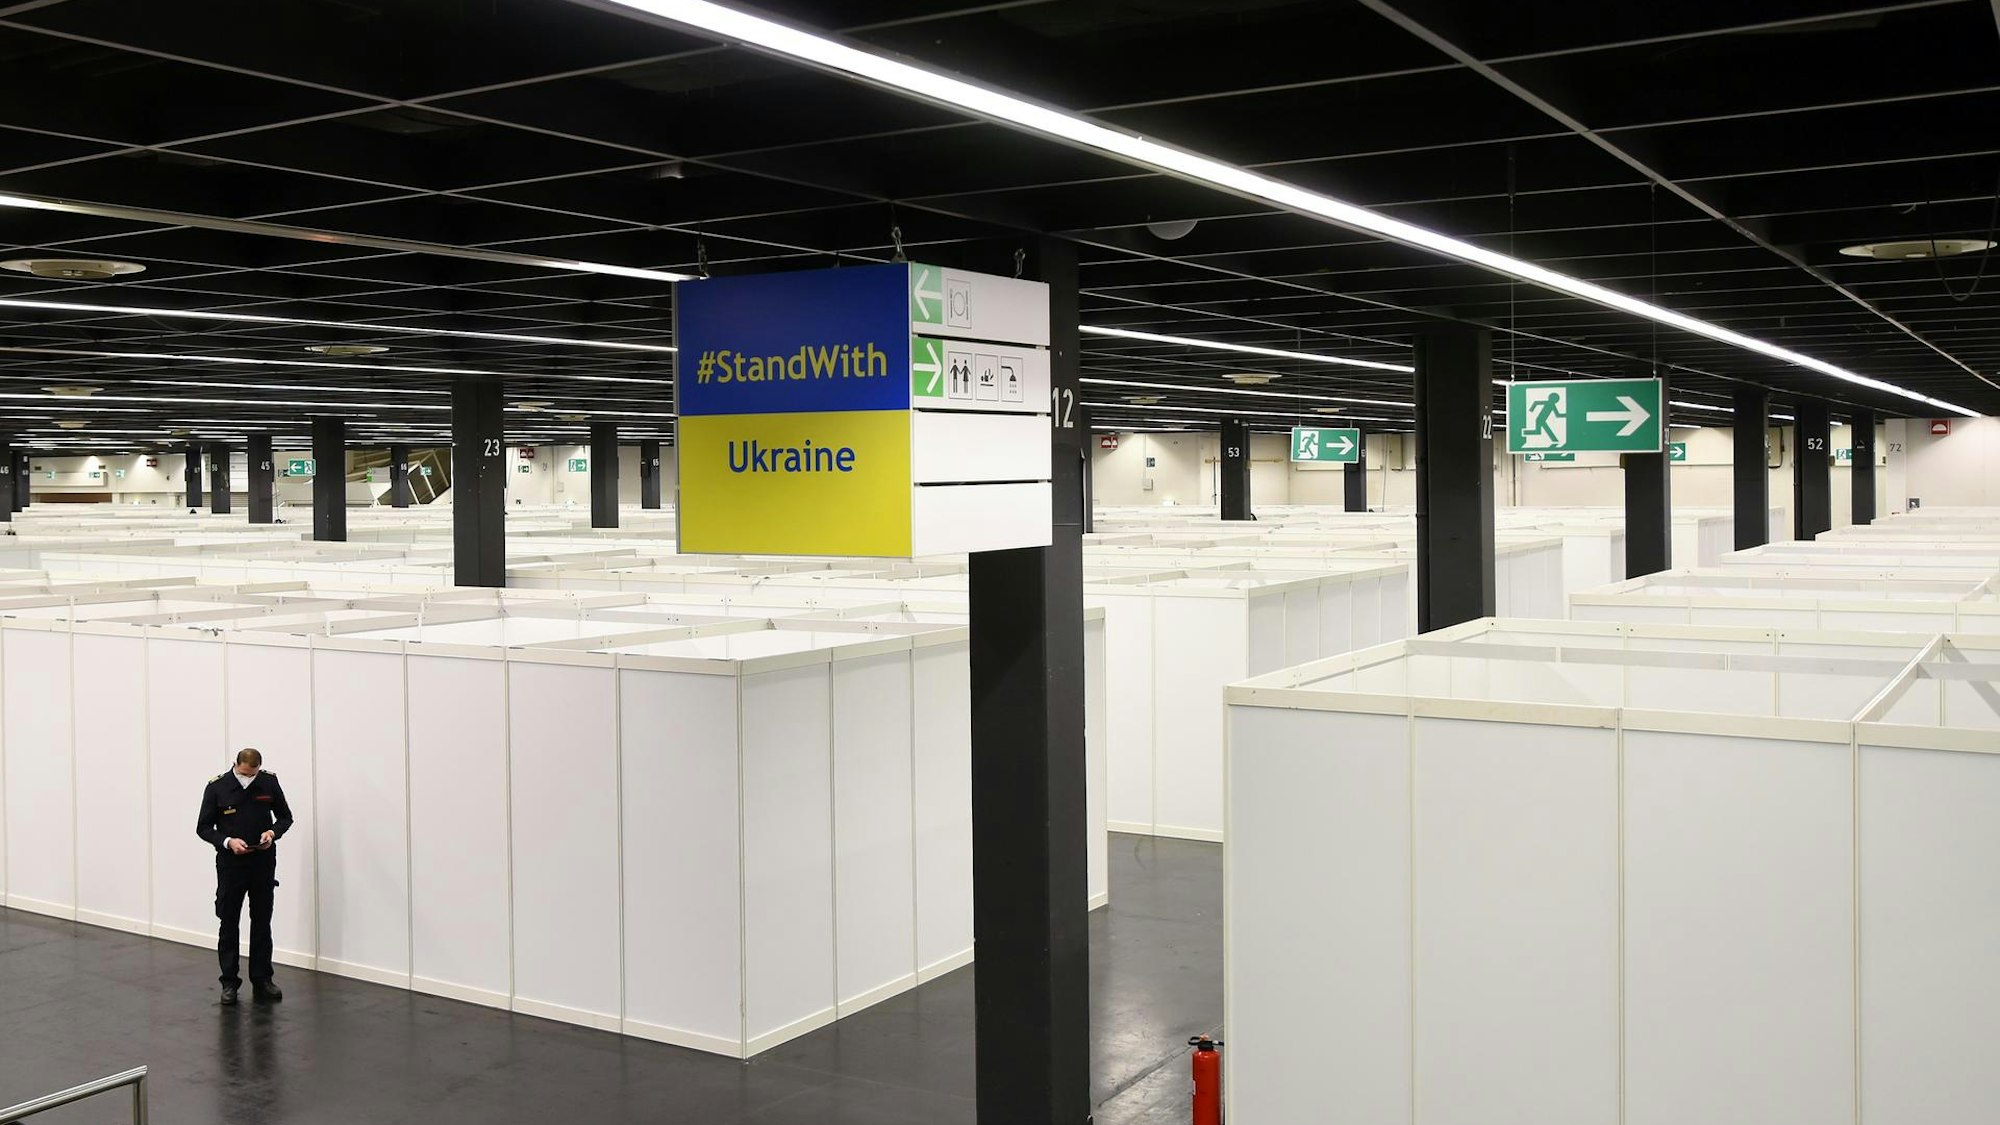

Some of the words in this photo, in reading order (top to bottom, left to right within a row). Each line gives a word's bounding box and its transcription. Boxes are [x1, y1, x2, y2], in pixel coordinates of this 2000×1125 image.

[697, 342, 887, 384] #StandWith
[1052, 387, 1074, 428] 12
[1482, 414, 1492, 439] 22
[484, 438, 500, 456] 23
[1228, 447, 1240, 458] 53
[1807, 437, 1823, 450] 52
[1889, 443, 1902, 452] 72
[260, 460, 270, 470] 45
[728, 439, 856, 473] Ukraine
